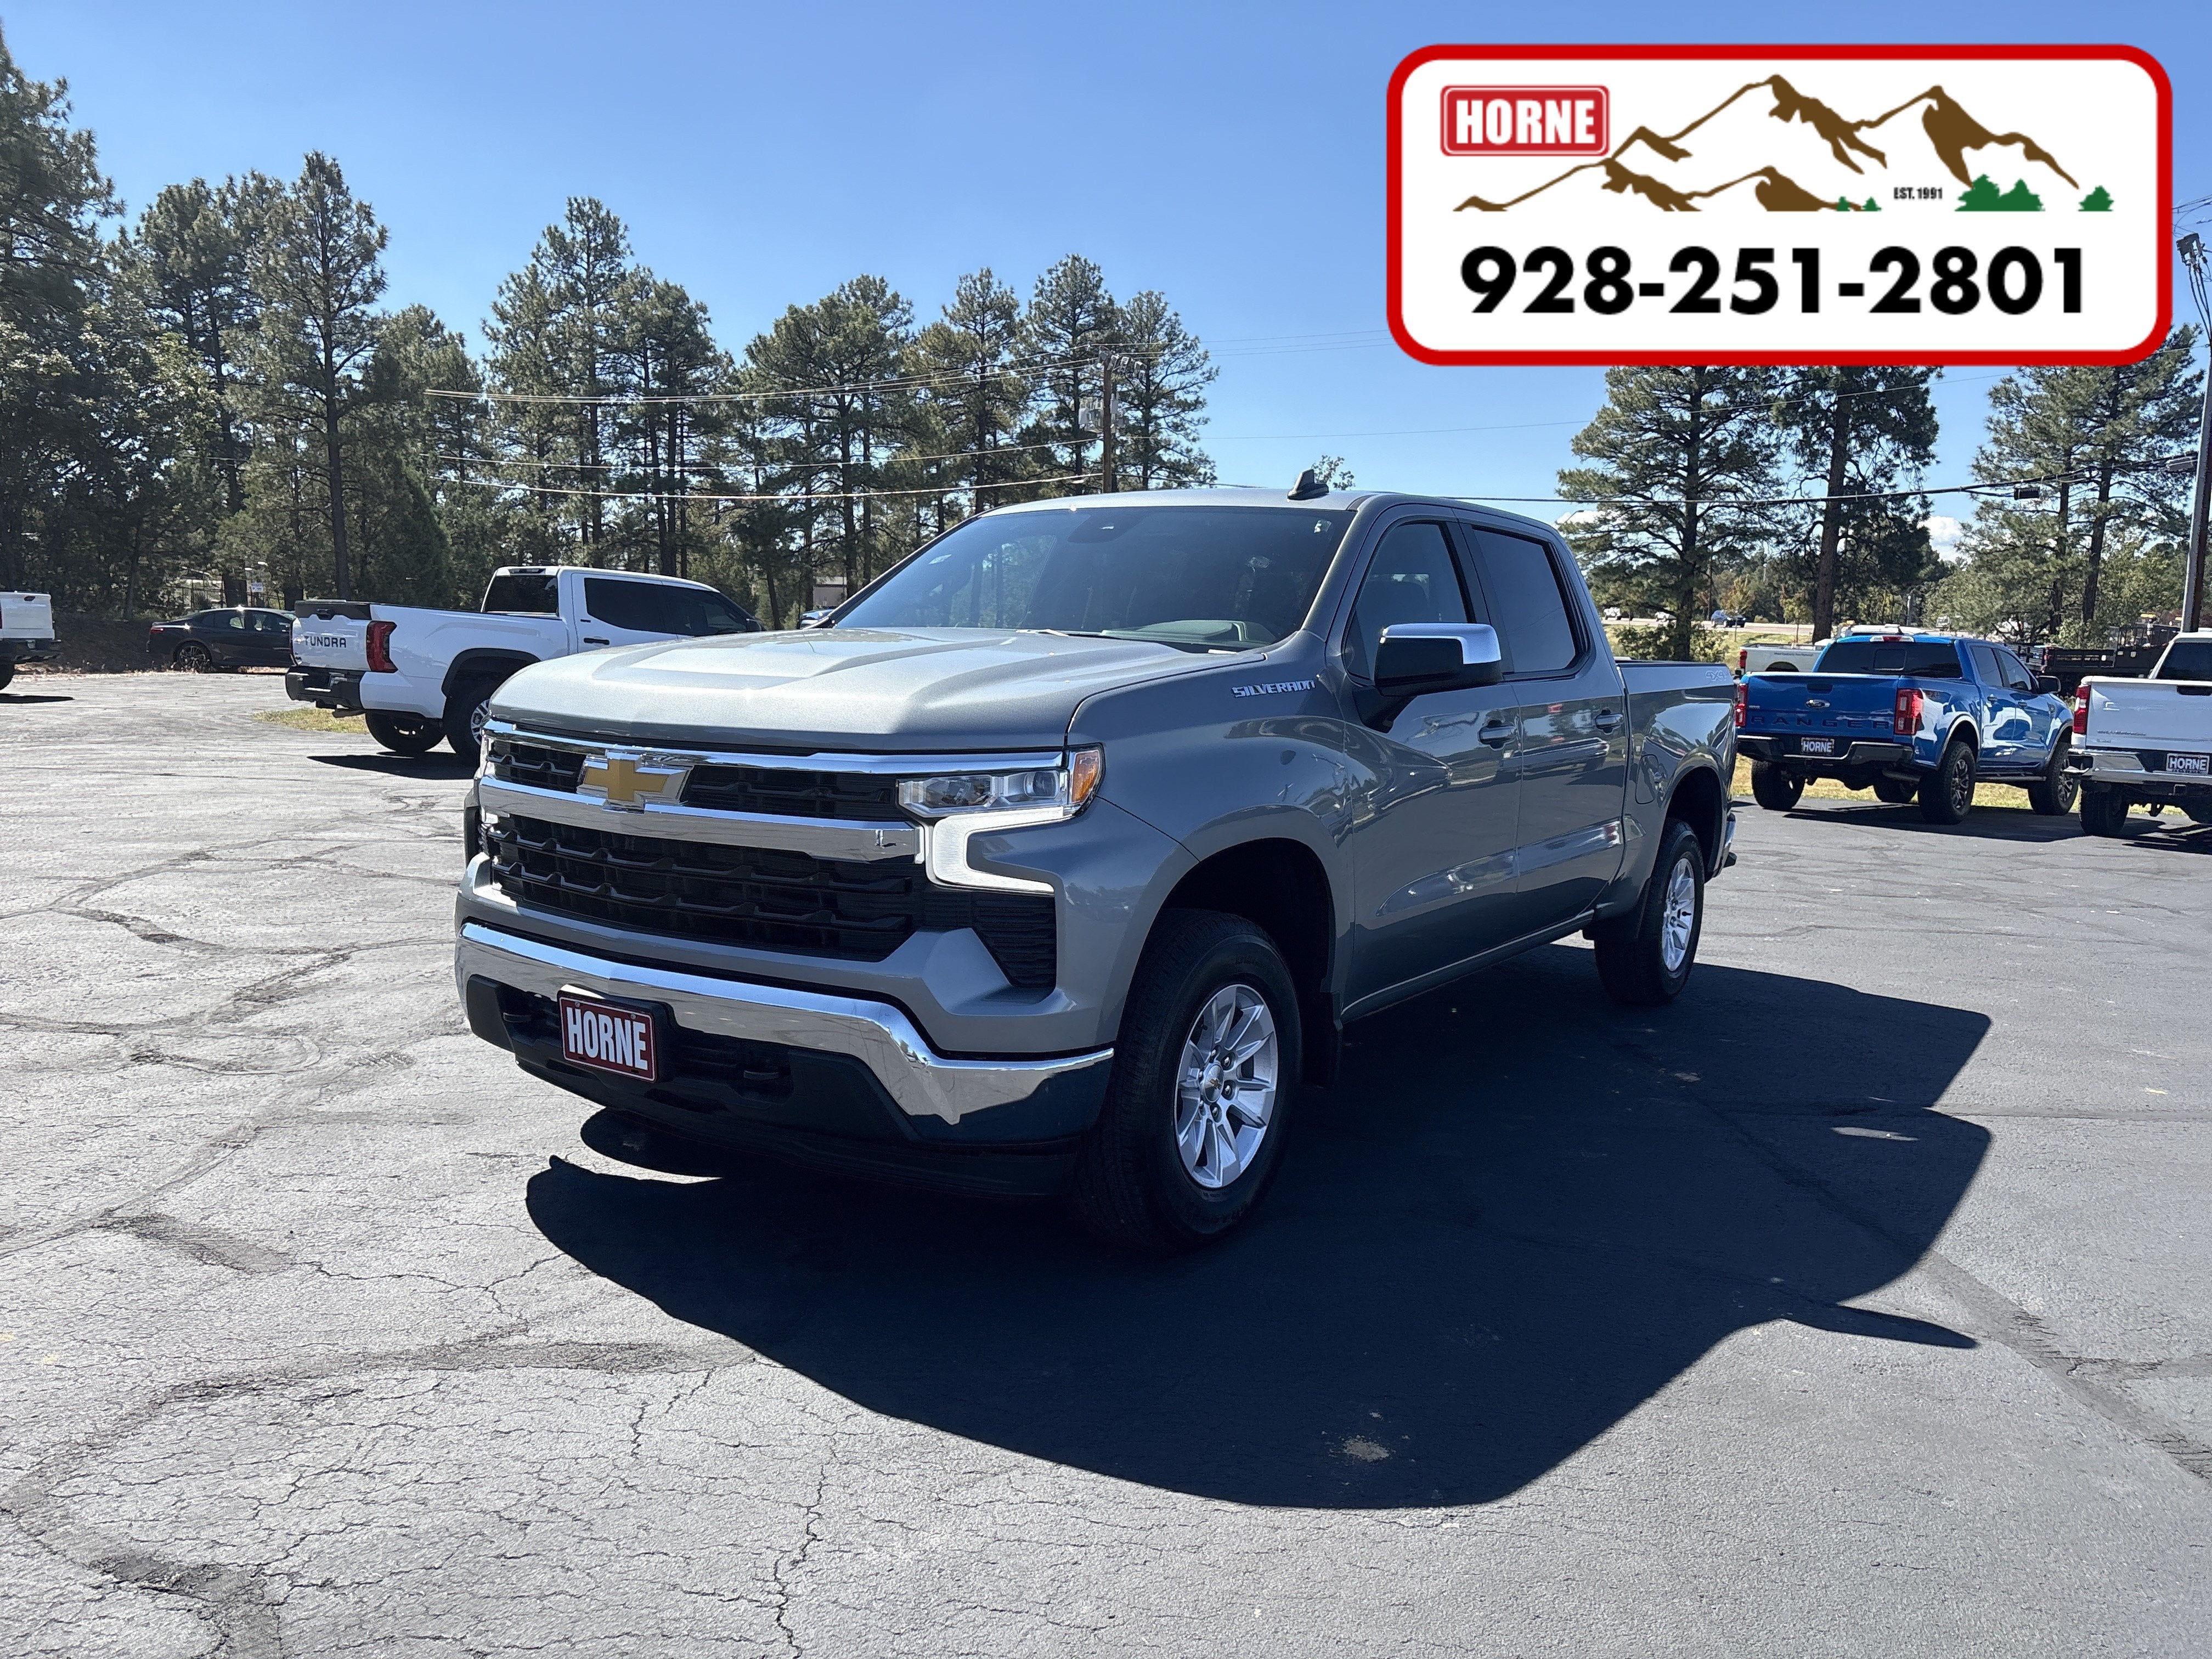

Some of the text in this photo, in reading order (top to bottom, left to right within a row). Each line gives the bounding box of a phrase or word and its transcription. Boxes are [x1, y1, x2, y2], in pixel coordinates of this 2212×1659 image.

[304, 636, 346, 648] TUNDRA
[1751, 715, 1889, 729] RANGER
[1803, 741, 1832, 752] HORNE
[2169, 757, 2207, 771] HORNE
[566, 1007, 648, 1070] HORNE
